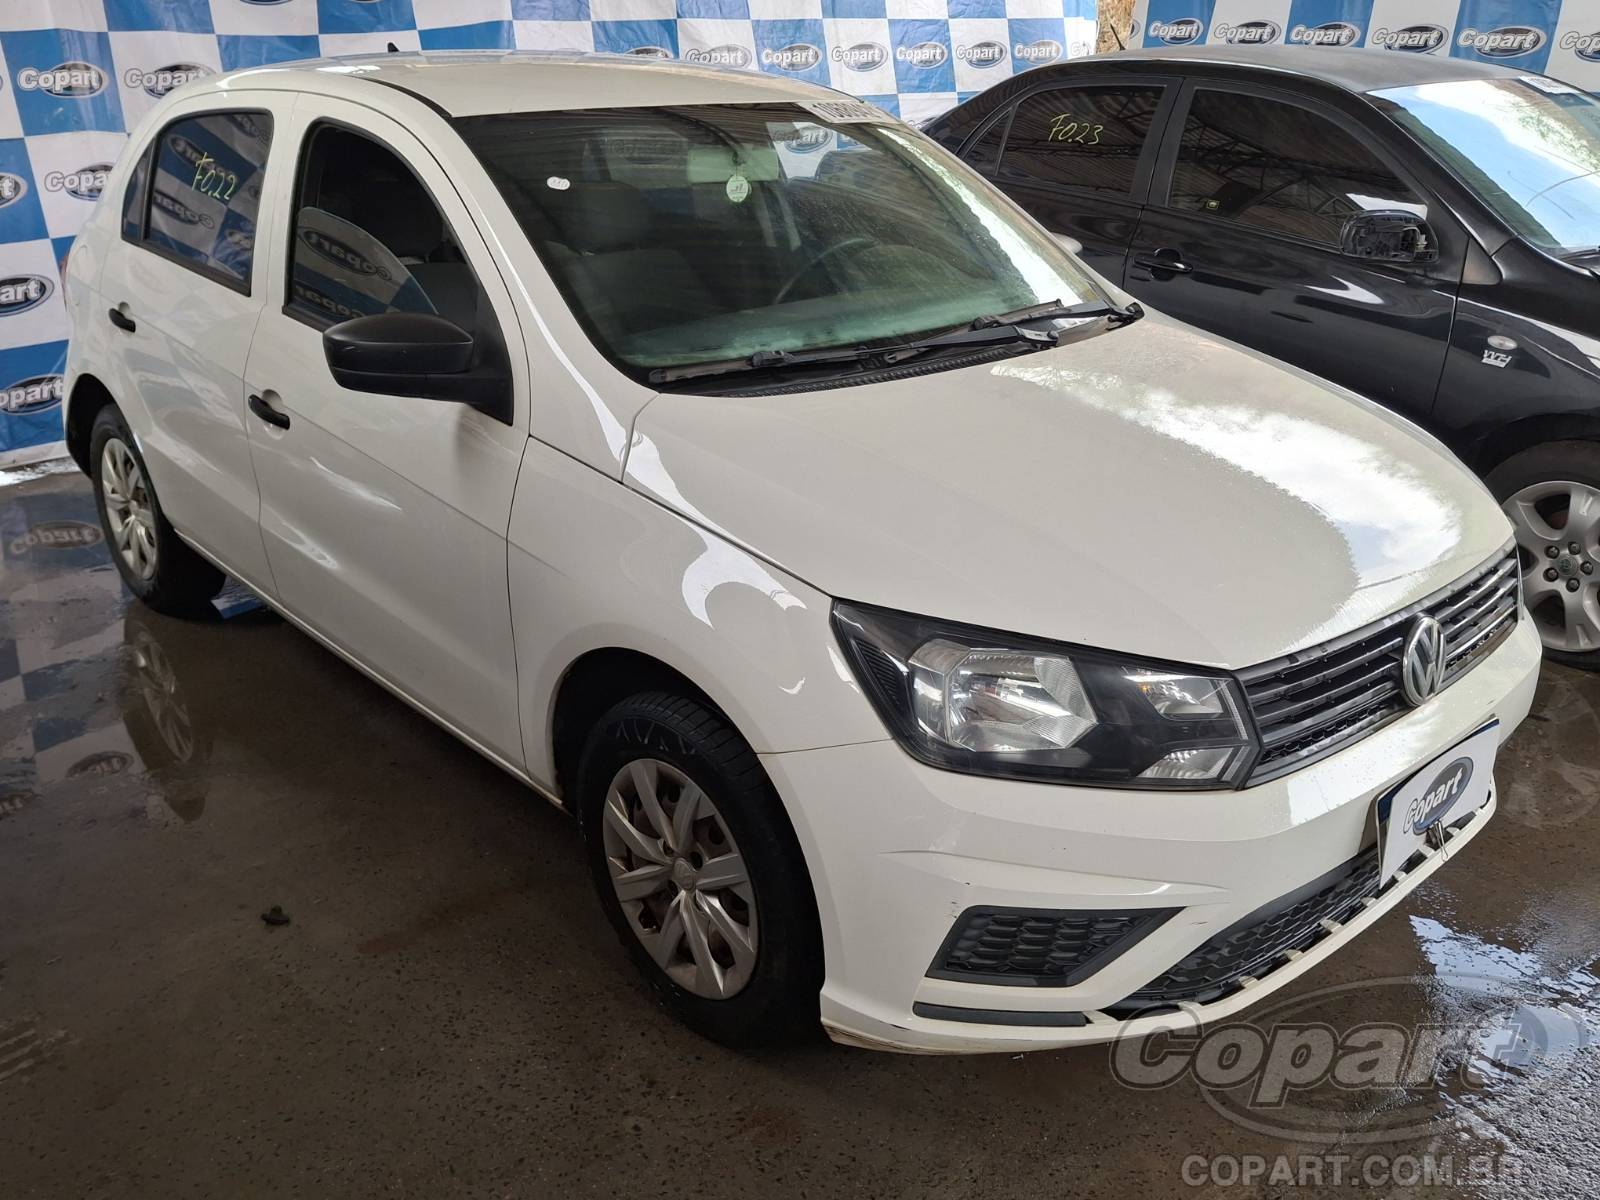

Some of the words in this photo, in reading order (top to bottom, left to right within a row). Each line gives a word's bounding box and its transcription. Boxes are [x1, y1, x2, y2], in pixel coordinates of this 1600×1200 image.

[1149, 20, 1200, 40] Copart
[1214, 22, 1273, 44] Copart
[1290, 24, 1355, 46] Copart
[1372, 28, 1442, 49] Copart
[1457, 28, 1540, 52] Copart
[686, 48, 743, 65] Copart
[761, 48, 816, 68] Copart
[832, 46, 881, 66] Copart
[896, 45, 942, 62] Copart
[956, 44, 1002, 61] Copart
[1015, 42, 1060, 60] Copart
[18, 67, 101, 92] Copart
[1403, 767, 1463, 834] Copart
